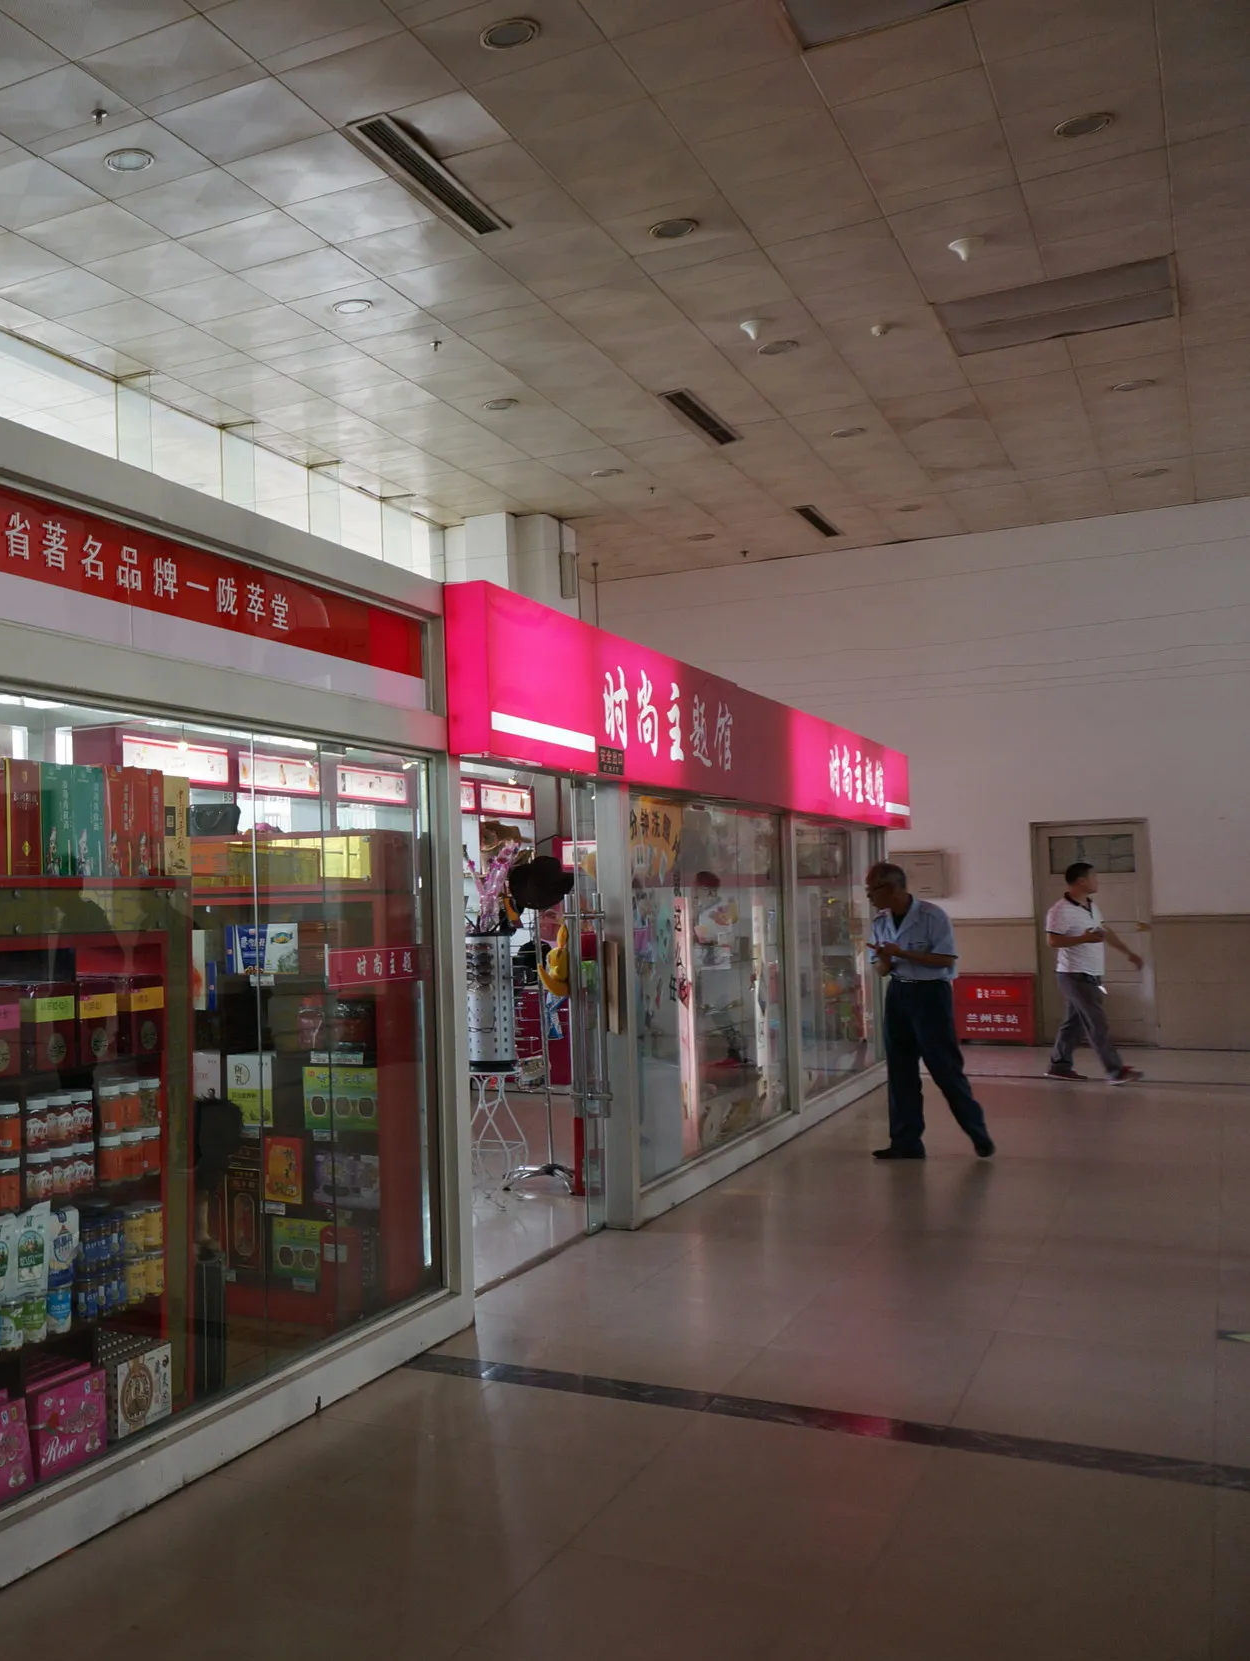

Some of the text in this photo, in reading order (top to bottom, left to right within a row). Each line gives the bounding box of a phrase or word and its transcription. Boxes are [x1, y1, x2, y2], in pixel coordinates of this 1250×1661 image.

[602, 665, 735, 771] 时尚主题馆
[599, 748, 623, 765] 安全出口
[602, 765, 620, 774] EXIT
[828, 743, 886, 810] 时尚主题馆
[965, 1012, 1019, 1025] 兰州车站
[40, 1435, 78, 1467] Rose
